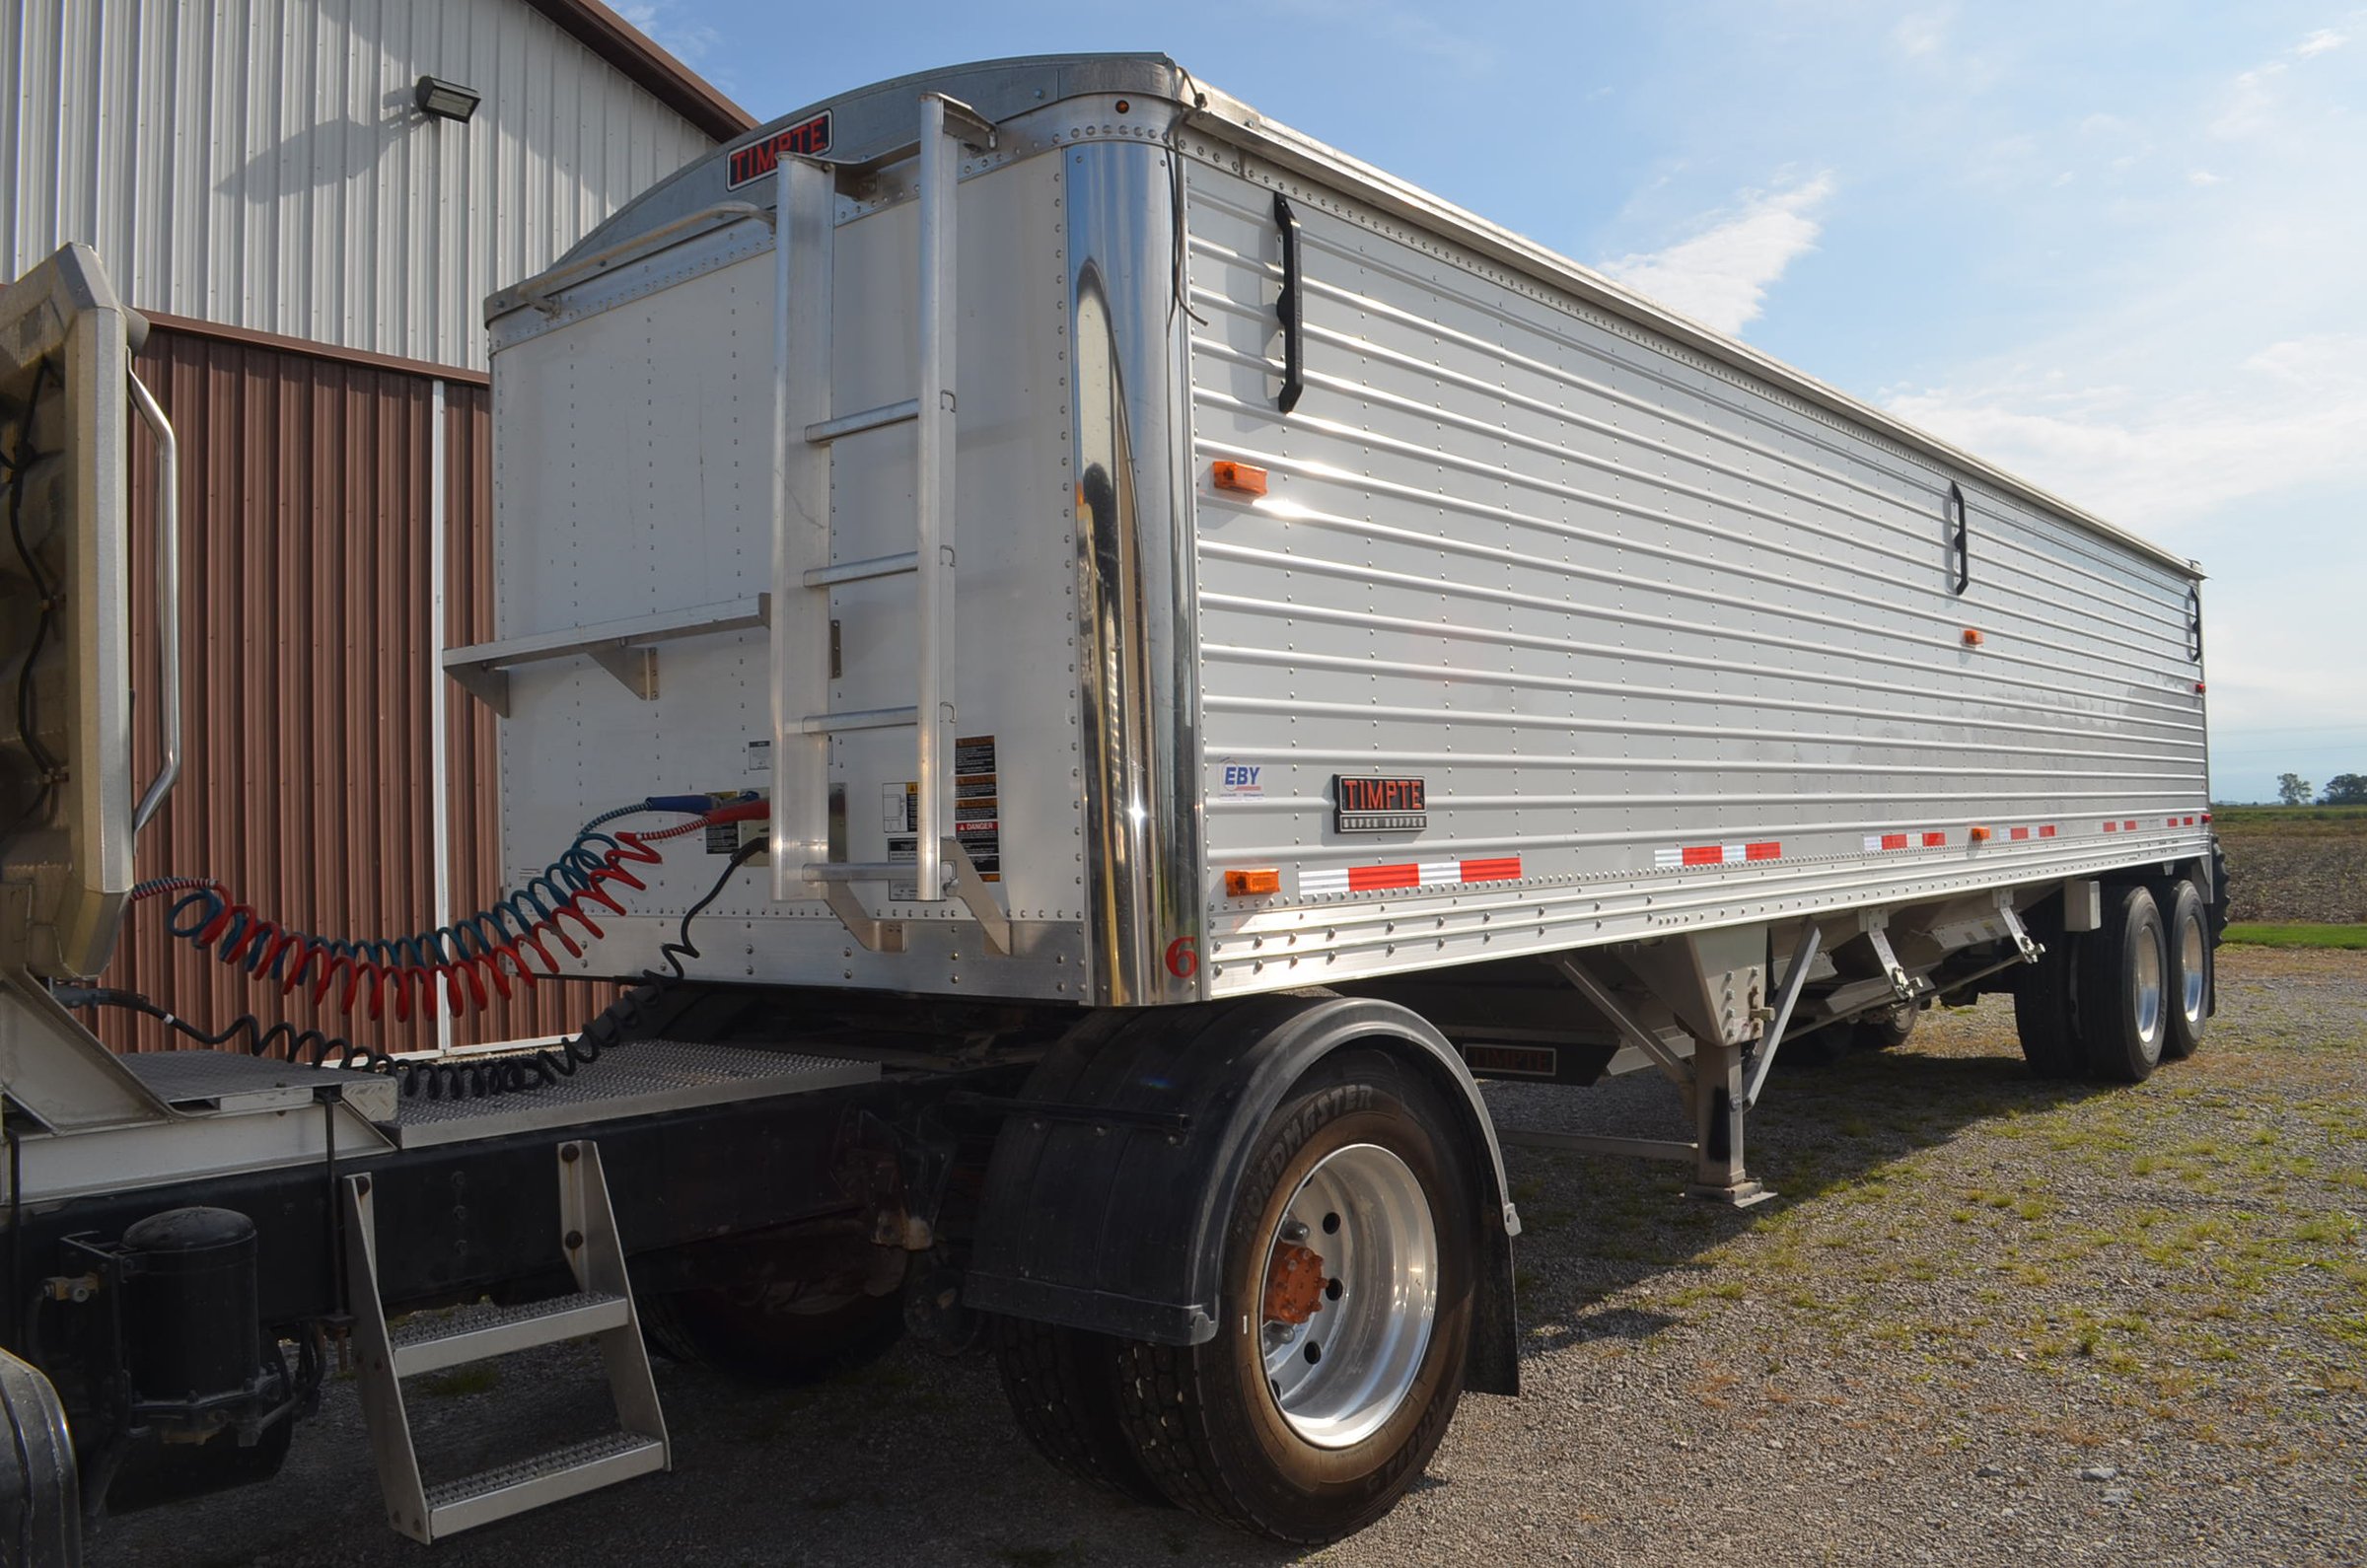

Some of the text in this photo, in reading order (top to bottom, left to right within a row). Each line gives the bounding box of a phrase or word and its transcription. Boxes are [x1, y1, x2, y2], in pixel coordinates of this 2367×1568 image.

[732, 116, 825, 182] TIMPTE
[1225, 766, 1260, 785] EBY
[1343, 780, 1422, 810] TIMPTE
[1165, 936, 1198, 978] 6
